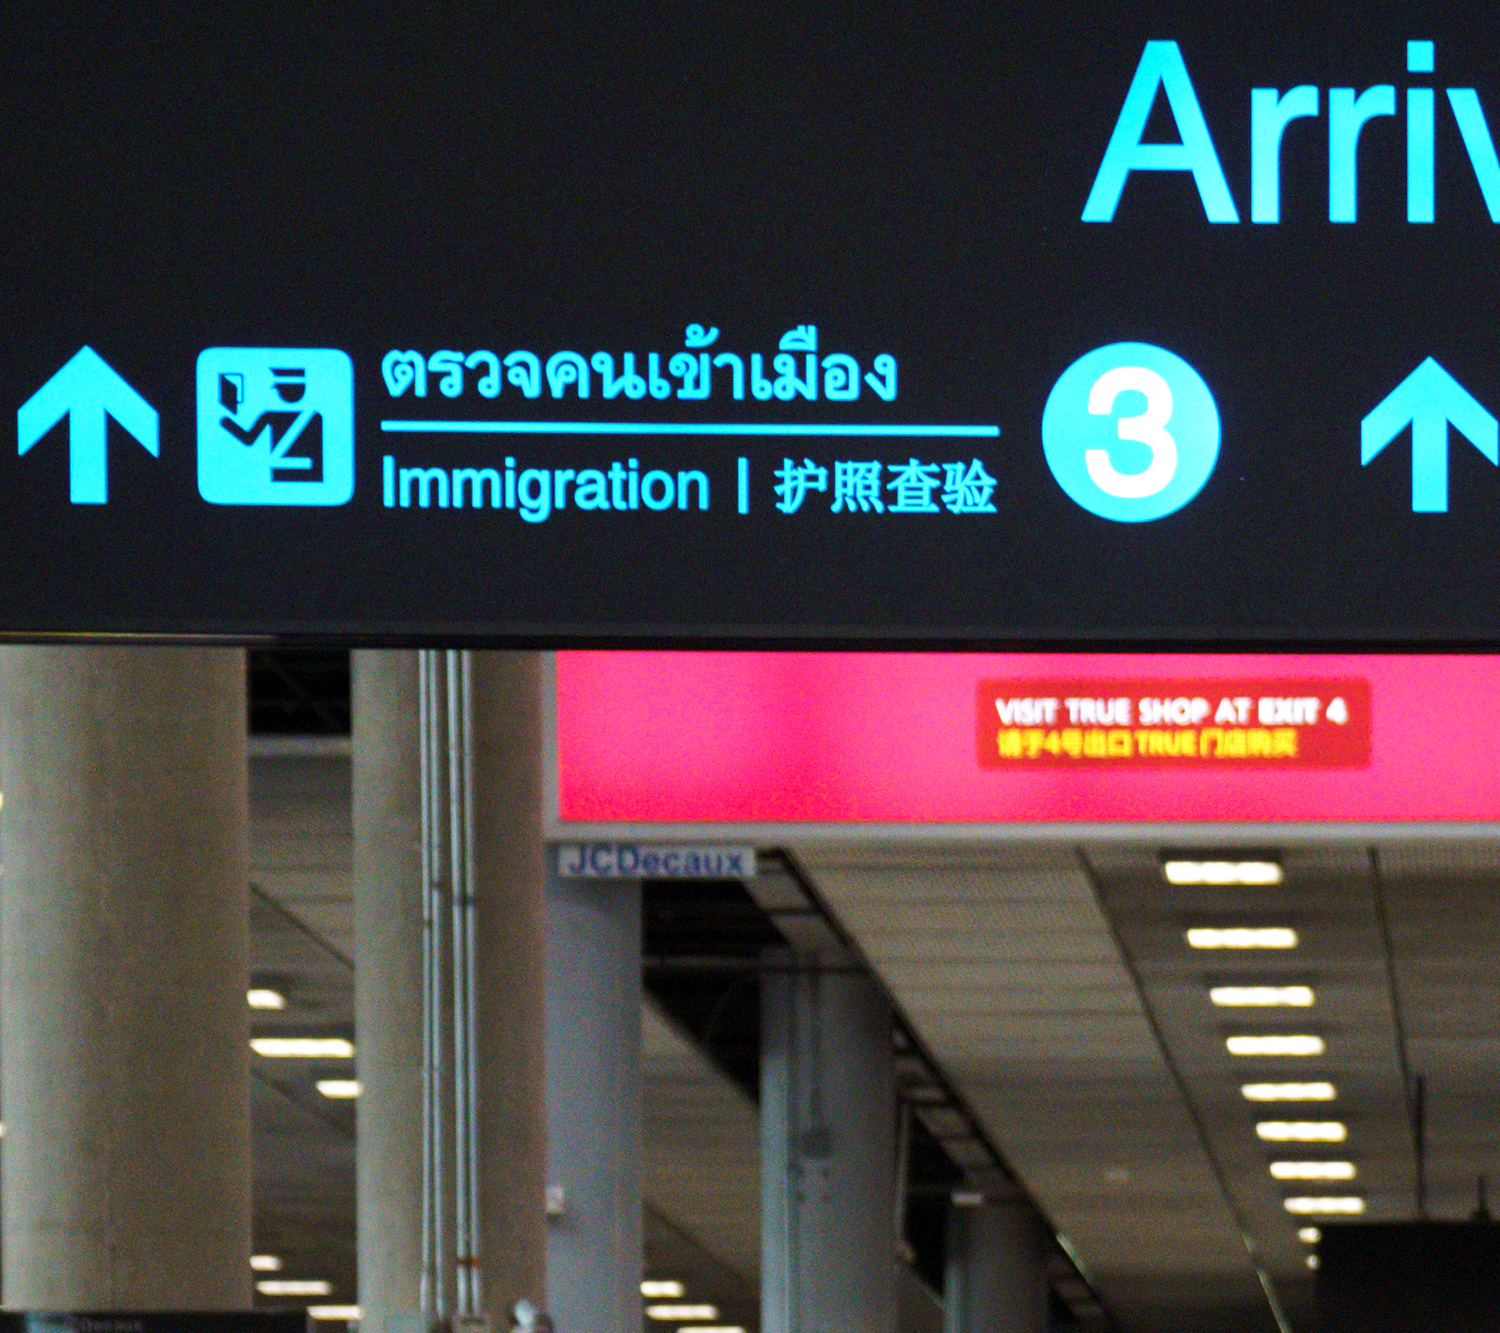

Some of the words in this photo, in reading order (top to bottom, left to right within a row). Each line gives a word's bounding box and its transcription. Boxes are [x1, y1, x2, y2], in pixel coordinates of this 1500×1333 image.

[380, 322, 898, 403] ตรวจคนเข้าเมือง
[1085, 366, 1178, 498] 3
[382, 454, 710, 524] Immigration
[773, 457, 998, 515] 护照查验
[995, 698, 1058, 725] VISIT
[1065, 698, 1131, 725] TRUE
[1139, 698, 1209, 725] SHOP
[1215, 697, 1252, 724] AT
[1258, 697, 1319, 725] EXIT
[1326, 697, 1347, 724] 4
[568, 844, 743, 877] JCDecaux
